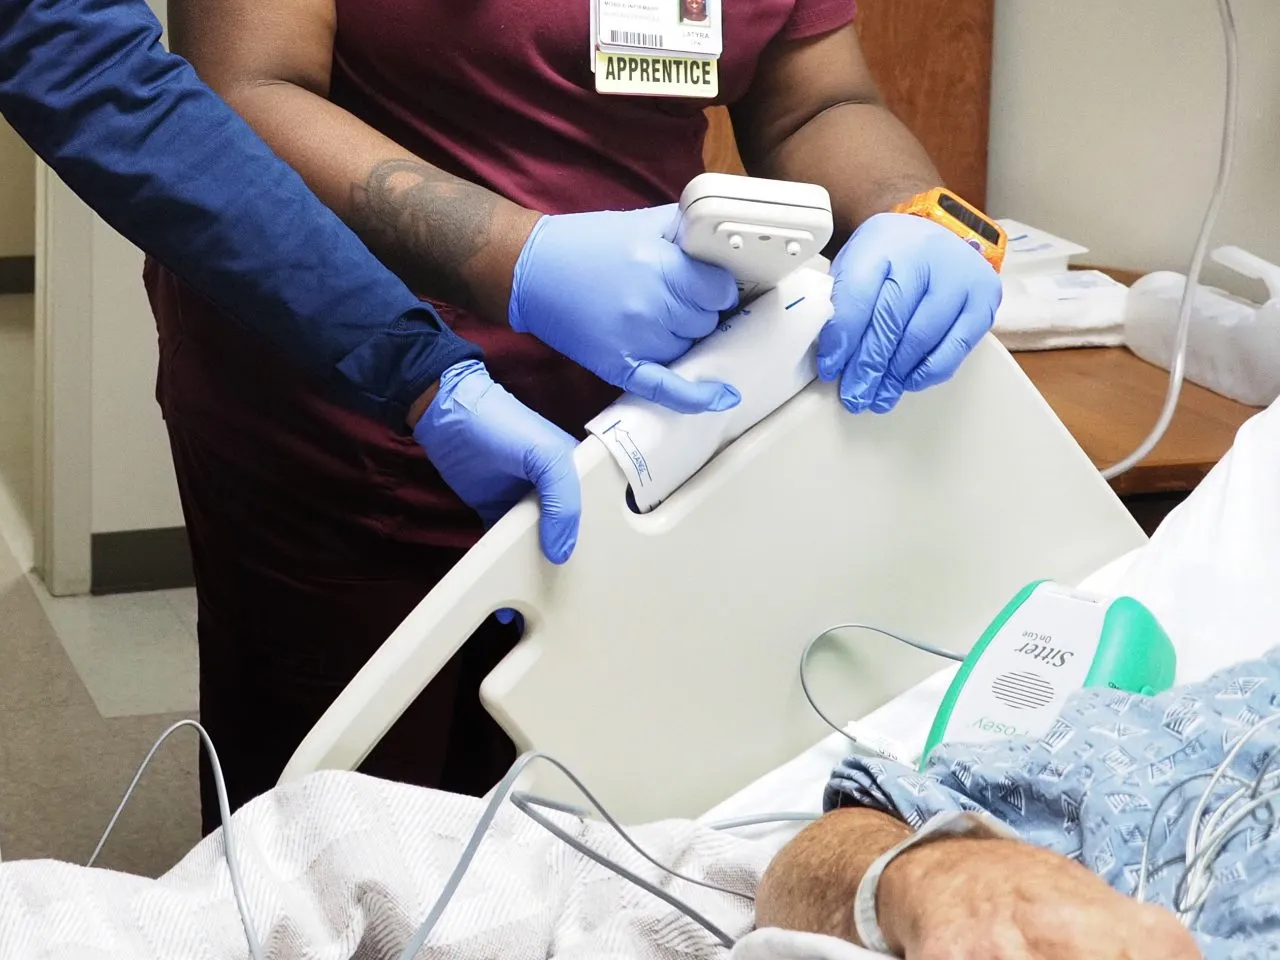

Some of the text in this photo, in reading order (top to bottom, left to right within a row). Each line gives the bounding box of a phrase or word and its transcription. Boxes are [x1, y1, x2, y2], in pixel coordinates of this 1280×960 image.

[605, 56, 711, 85] APPRENTICE
[1022, 630, 1052, 644] On Cue
[1014, 642, 1074, 667] Sitter
